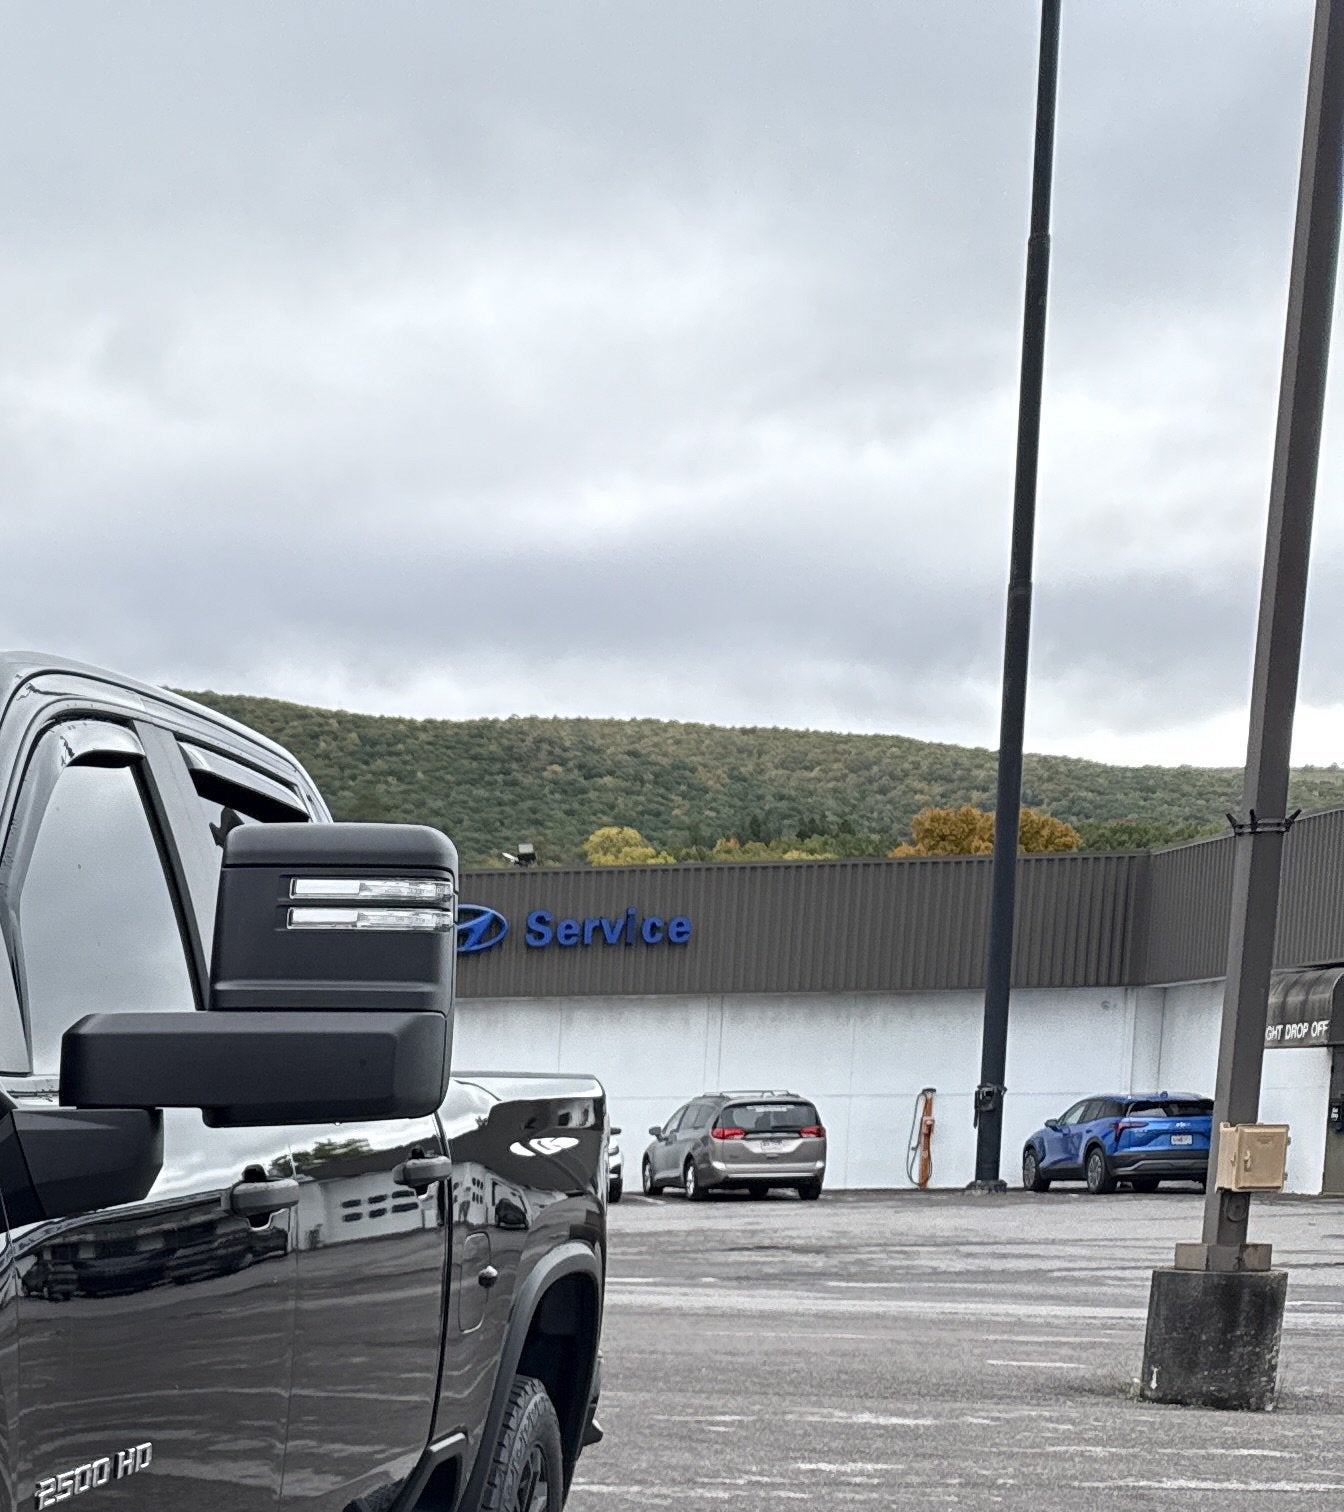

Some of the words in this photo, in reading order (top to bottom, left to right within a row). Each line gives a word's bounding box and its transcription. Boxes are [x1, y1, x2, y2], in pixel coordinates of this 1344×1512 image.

[525, 906, 693, 948] Service
[1285, 1022, 1309, 1041] DROP
[1310, 1020, 1330, 1038] OFF
[34, 1456, 111, 1511] 2500
[113, 1441, 153, 1480] HD
